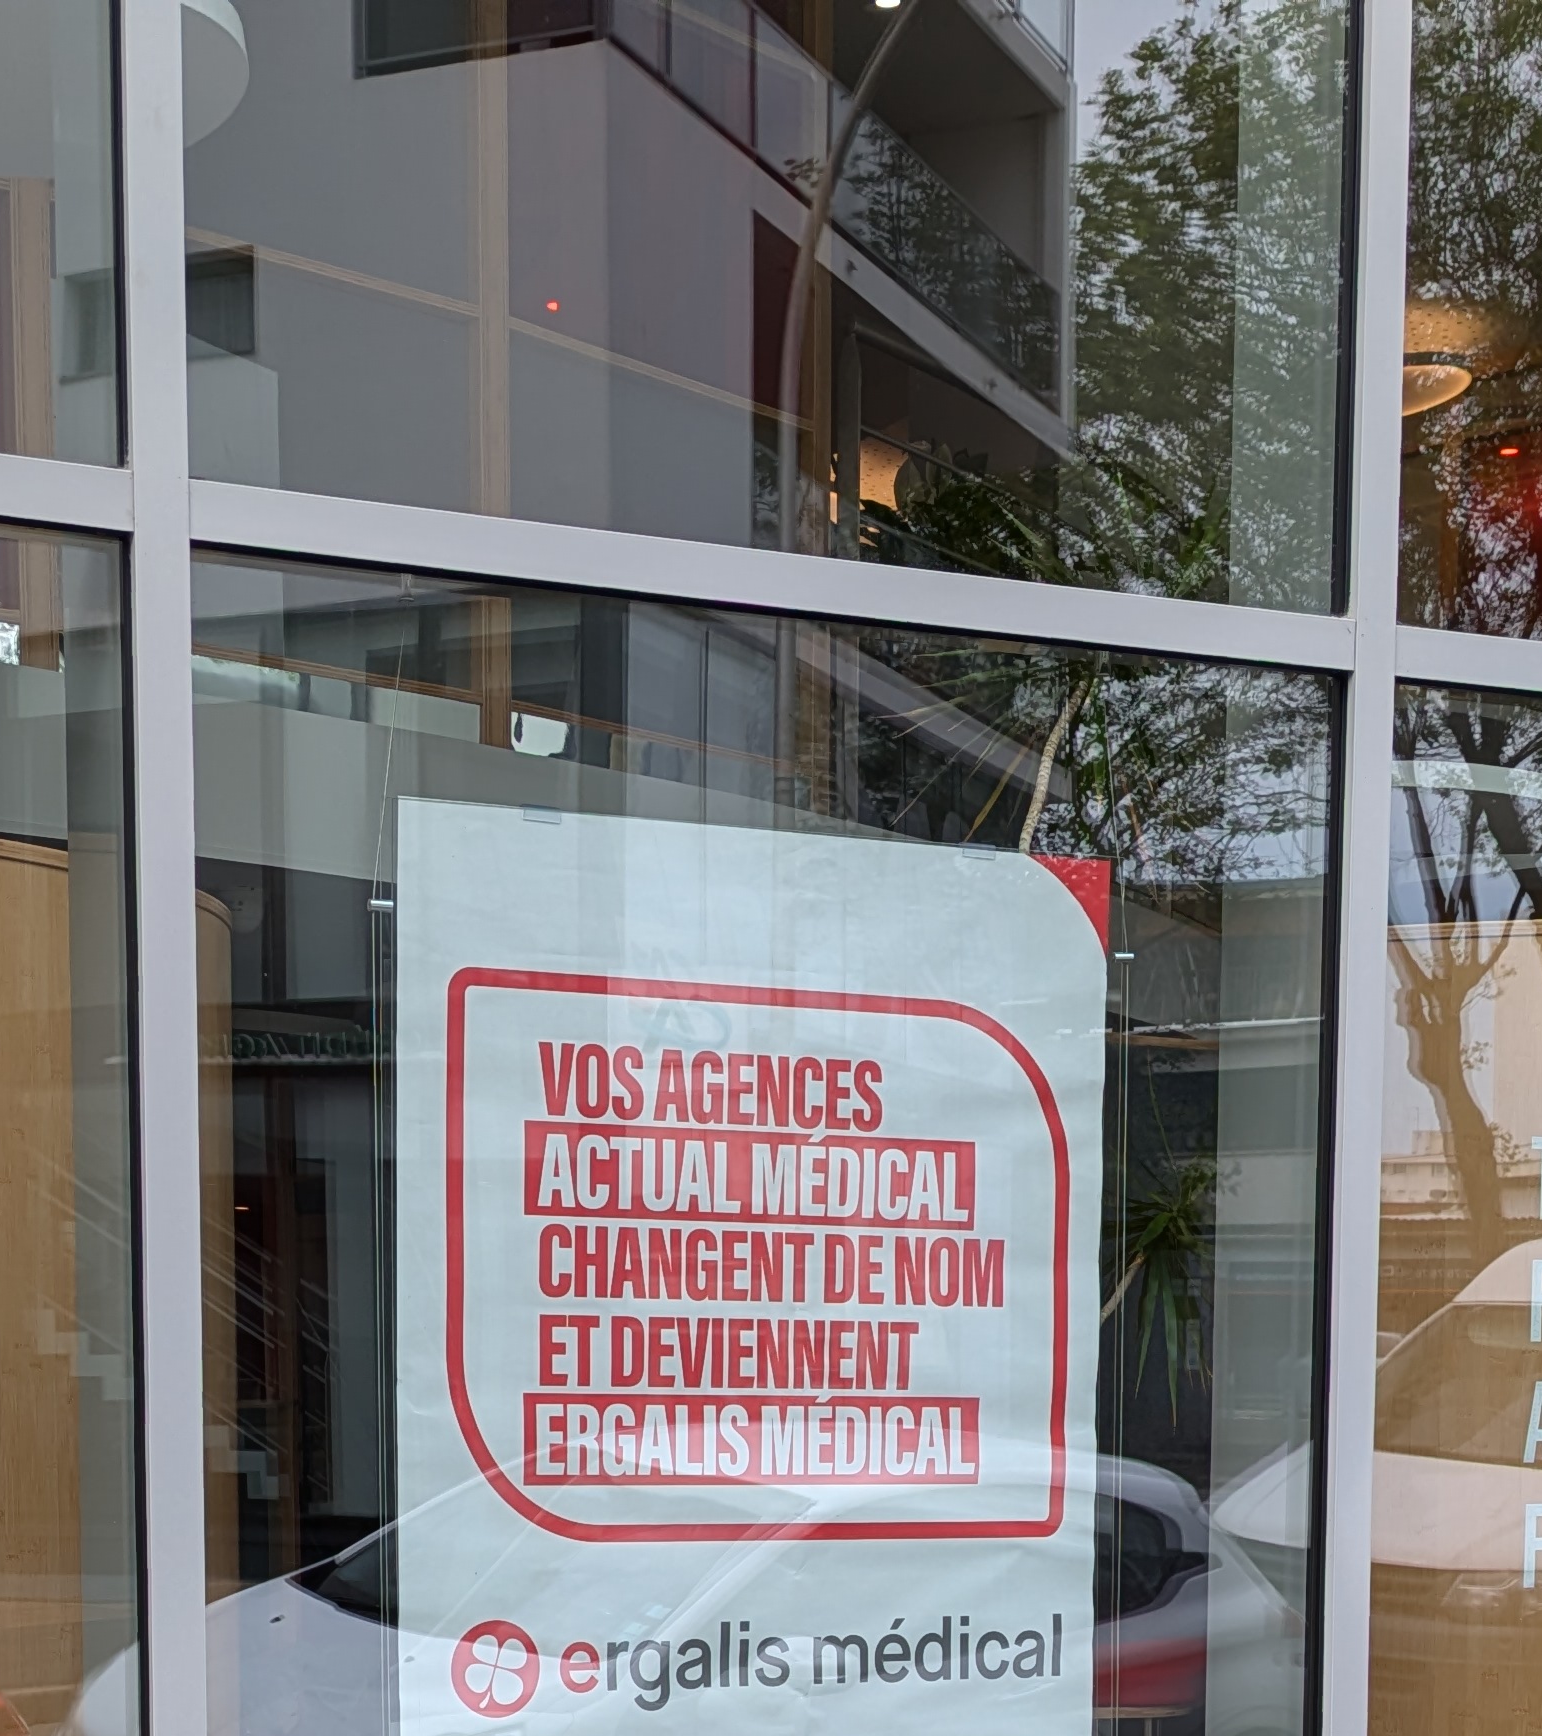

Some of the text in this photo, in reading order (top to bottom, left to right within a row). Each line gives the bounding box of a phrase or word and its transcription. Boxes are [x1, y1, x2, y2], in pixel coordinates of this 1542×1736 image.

[538, 1041, 883, 1133] VOS AGENCES
[537, 1130, 969, 1221] ACTUAL MÉDICAL
[538, 1225, 1004, 1308] CHANGENT DE NOM
[539, 1314, 919, 1391] ET DEVIENNENT
[536, 1392, 977, 1476] ERGALIS MÉDICAL
[559, 1614, 1063, 1711] ergalis médical
